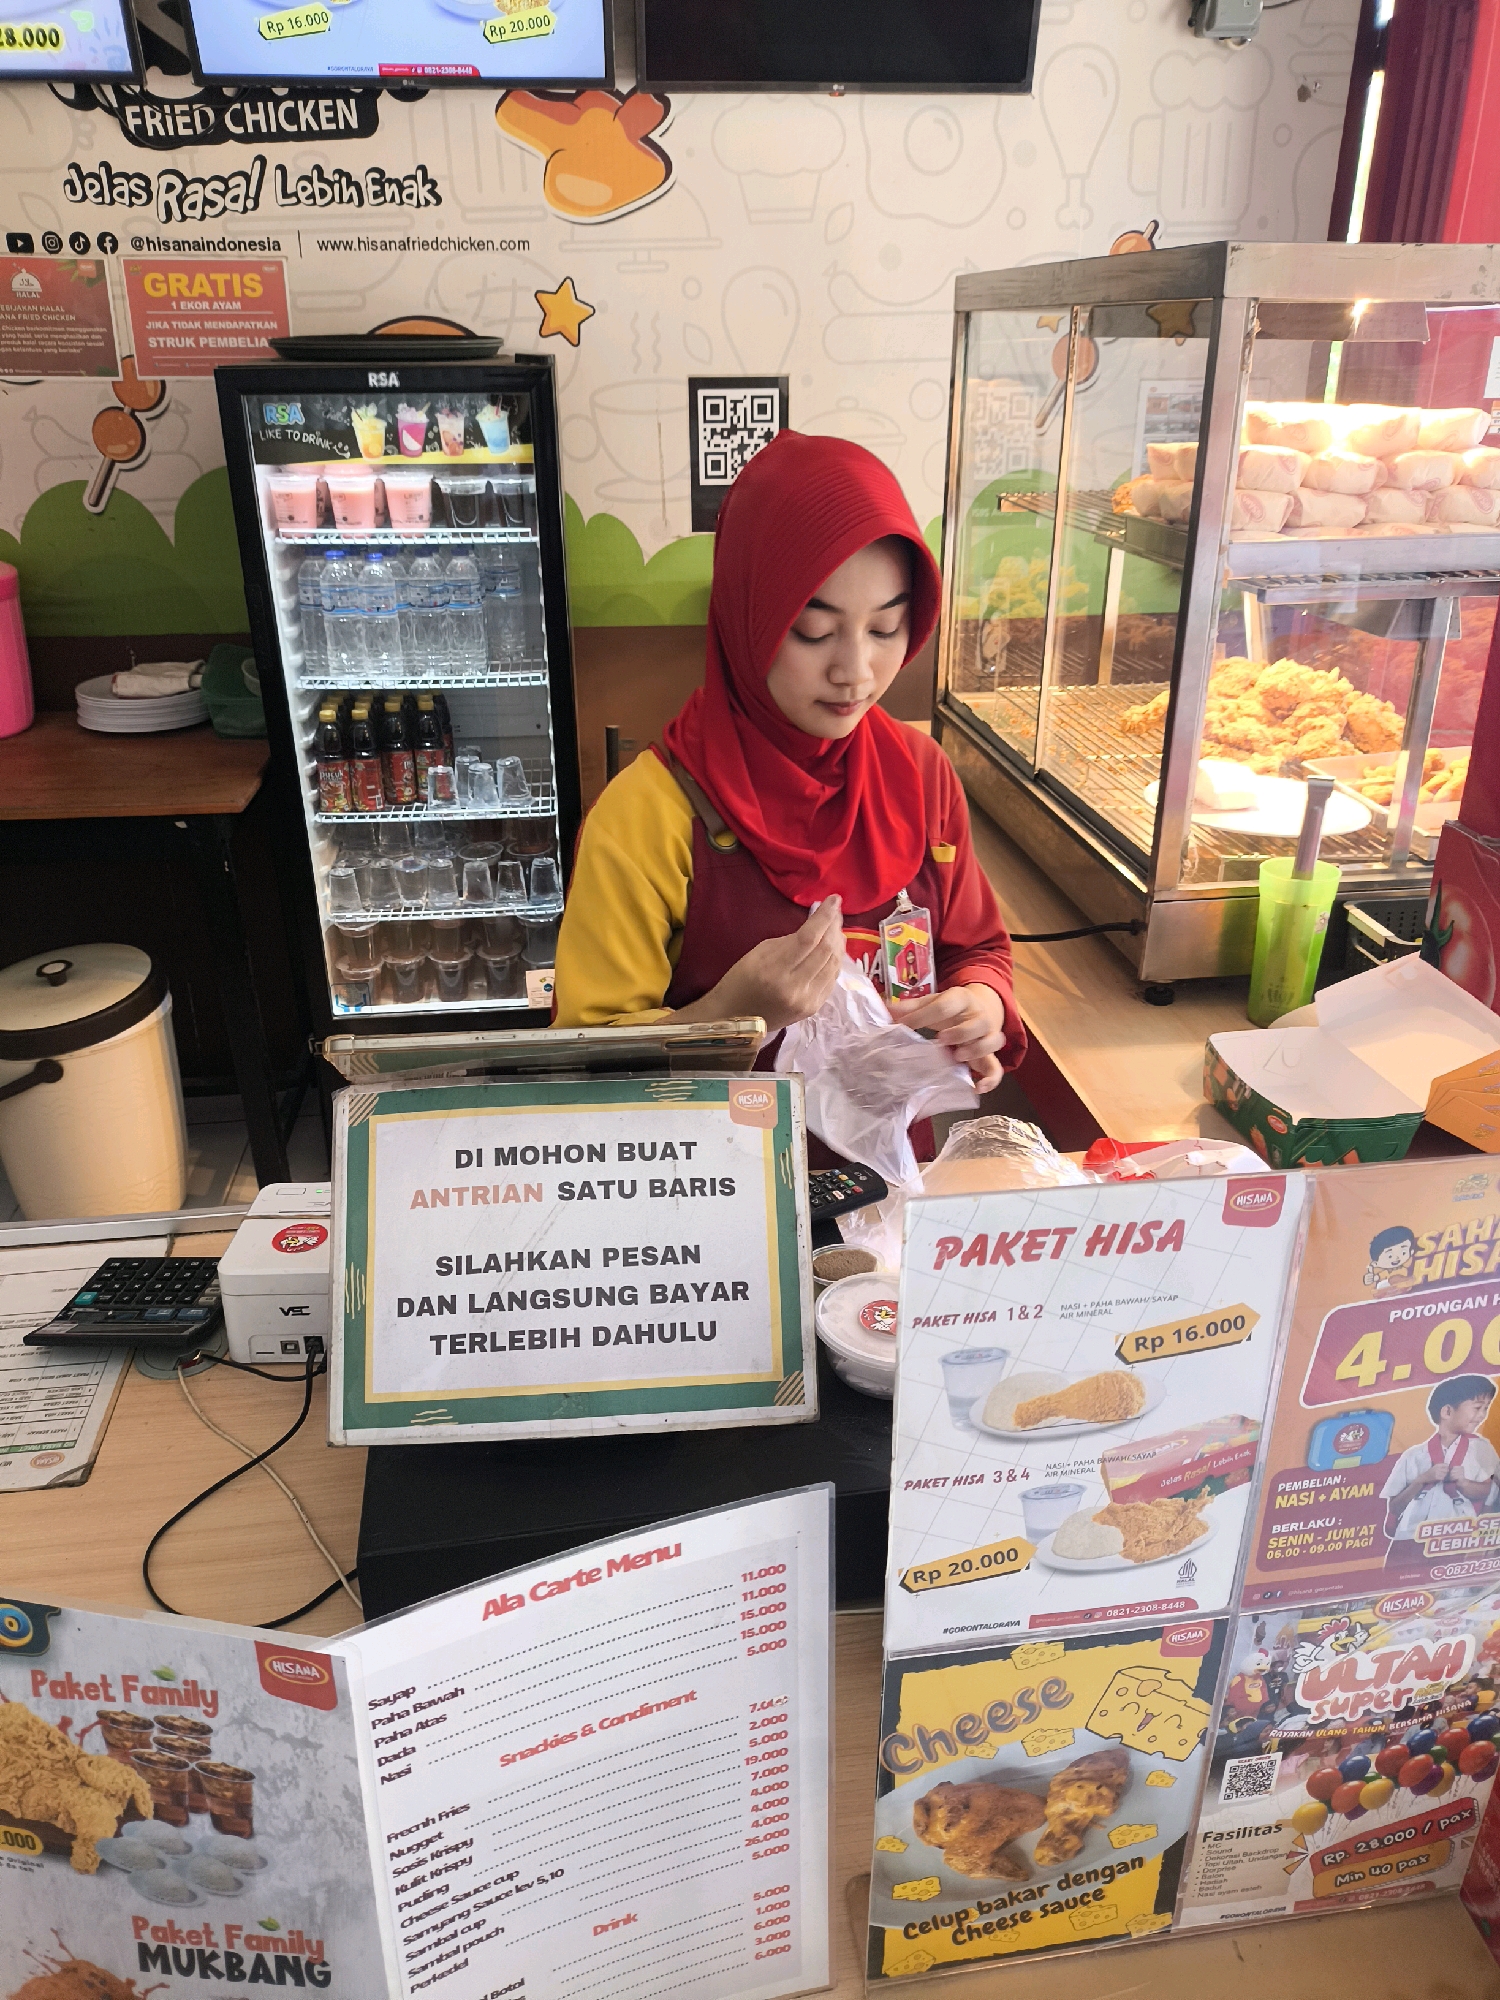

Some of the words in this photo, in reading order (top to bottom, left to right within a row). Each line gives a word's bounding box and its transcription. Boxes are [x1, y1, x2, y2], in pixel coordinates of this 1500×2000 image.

[266, 20, 285, 34] Rp
[287, 10, 329, 30] 16.000
[489, 24, 507, 40] Rp
[509, 14, 551, 34] 20.000
[124, 103, 215, 137] FRIED
[223, 98, 359, 134] CHICKEN
[64, 161, 152, 207] Jelas
[156, 154, 268, 223] Rasa!
[274, 164, 363, 208] Lebih
[363, 164, 442, 208] Enak
[130, 235, 281, 253] @hisanaindonesia
[316, 236, 531, 252] www.hisanafriedchicken.com
[143, 272, 264, 298] GRATIS
[180, 301, 210, 310] EKOR
[212, 301, 242, 310] AYAM
[146, 321, 170, 330] JIKA
[171, 321, 202, 330] TIDAK
[204, 321, 278, 330] MENDAPATKAN
[148, 336, 197, 349] STRUK
[200, 336, 271, 349] PEMBELIA
[368, 371, 400, 388] RSA
[263, 402, 305, 425] RSA
[259, 429, 282, 441] LIKE
[454, 1148, 483, 1169] DI
[493, 1142, 607, 1168] MOHON
[617, 1140, 699, 1164] BUAT
[409, 1182, 544, 1210] ANTRIAN
[556, 1178, 638, 1202] SATU
[648, 1176, 737, 1198] BARIS
[1235, 1191, 1273, 1207] HISANA
[932, 1225, 1078, 1272] PAKET
[1083, 1218, 1187, 1258] HISA
[434, 1247, 591, 1277] SILAHKAN
[602, 1244, 701, 1269] PESAN
[396, 1294, 458, 1319] DAN
[467, 1284, 639, 1315] LANGSUNG
[648, 1281, 750, 1305] BAYAR
[1059, 1312, 1074, 1320] AIR
[1075, 1308, 1114, 1319] MINERAL
[1060, 1303, 1081, 1312] NASI
[1090, 1300, 1113, 1309] PAHA
[1151, 1294, 1179, 1304] SAYAP
[1389, 1294, 1489, 1323] POTONGAN
[911, 1313, 961, 1329] PAKET
[962, 1310, 997, 1325] HISA
[1134, 1335, 1165, 1353] Rp
[1171, 1314, 1246, 1346] 16.000
[429, 1326, 581, 1357] TERLEBIH
[591, 1320, 718, 1348] DAHULU
[1045, 1462, 1066, 1471] NASI
[1073, 1459, 1095, 1468] PAHA
[1060, 1467, 1096, 1477] MINERAL
[903, 1477, 950, 1491] PAKET
[951, 1473, 985, 1487] HISA
[1160, 1474, 1182, 1488] Jelas
[1275, 1490, 1314, 1509] NASI
[1329, 1482, 1375, 1502] AYAM
[1267, 1532, 1314, 1550] SENIN
[1420, 1520, 1474, 1538] BEKAL
[1266, 1548, 1300, 1560] 06.00
[1309, 1542, 1342, 1556] 09.00
[1345, 1536, 1374, 1550] PAGI
[1429, 1536, 1480, 1552] LEBIH
[913, 1568, 942, 1586] Rp
[948, 1547, 1020, 1577] 20.000
[482, 1592, 526, 1621] Ala
[529, 1567, 602, 1602] Carte
[606, 1542, 682, 1578] Menu
[942, 1619, 1021, 1635] #GORONTALORAYA
[1105, 1600, 1186, 1618] 0821-2308-8448
[1383, 1595, 1425, 1613] HISANA
[368, 1686, 416, 1711] Sayap
[740, 1563, 787, 1584] 11.000
[1171, 1630, 1204, 1642] HISANA
[272, 1660, 320, 1679] HISANA
[371, 1709, 411, 1730] Paha
[412, 1687, 465, 1714] Bawah
[741, 1582, 787, 1603] 11.000
[1301, 1638, 1467, 1702] ULTAH
[374, 1726, 413, 1748] Paha
[415, 1713, 448, 1733] Atas
[740, 1601, 787, 1621] 15.000
[30, 1669, 116, 1702] Paket
[121, 1674, 219, 1718] Family
[377, 1745, 417, 1768] Dada
[740, 1620, 787, 1640] 15.000
[380, 1763, 412, 1785] Nasi
[746, 1638, 787, 1657] 5.000
[881, 1675, 1075, 1776] Cheese
[500, 1733, 579, 1768] Snackies
[598, 1689, 698, 1731] Condiment
[1268, 1729, 1314, 1738] RAYAKAN
[1315, 1727, 1348, 1738] ULANG
[1352, 1724, 1386, 1735] TAHUN
[389, 1830, 445, 1861] Nugget
[749, 1713, 788, 1731] 2.000
[392, 1856, 429, 1879] Sosis
[430, 1837, 474, 1862] Krispy
[748, 1730, 788, 1748] 5.000
[429, 1855, 473, 1880] Krispy
[744, 1747, 789, 1767] 19.000
[398, 1883, 450, 1912] Puding
[751, 1764, 789, 1782] 7.000
[1202, 1823, 1283, 1843] Fasilitas
[1322, 1852, 1350, 1866] Rp.
[1356, 1828, 1416, 1853] 28.000
[1439, 1809, 1473, 1831] pax
[400, 1901, 450, 1929] Cheese
[450, 1881, 492, 1906] Sauce
[493, 1869, 520, 1887] cup
[750, 1780, 790, 1797] 4.000
[1204, 1853, 1240, 1862] Dekorasi
[1242, 1847, 1280, 1858] Backdrop
[1206, 1848, 1233, 1856] Sound
[402, 1908, 472, 1947] Samyang
[515, 1880, 535, 1894] lev
[750, 1796, 790, 1814] 4.000
[1335, 1873, 1365, 1887] Min
[1371, 1864, 1392, 1876] 40
[1398, 1855, 1430, 1871] pax
[405, 1928, 459, 1963] Sambal
[751, 1812, 790, 1829] 4.000
[753, 1885, 790, 1901] 5.000
[903, 1907, 970, 1940] Celup
[976, 1882, 1051, 1917] bakar
[1056, 1856, 1145, 1893] dengan
[408, 1944, 461, 1979] Sambal
[462, 1925, 505, 1953] pouch
[744, 1828, 790, 1847] 26.000
[755, 1899, 790, 1916] 1.000
[951, 1914, 1034, 1946] Cheese
[1038, 1888, 1107, 1920] sauce
[410, 1957, 469, 1994] Perkedel
[751, 1843, 790, 1861] 5.000
[592, 1912, 639, 1937] Drink
[753, 1914, 791, 1931] 6.000
[131, 1914, 219, 1949] Paket
[224, 1923, 325, 1964] Family
[754, 1929, 791, 1946] 3.000
[754, 1943, 791, 1961] 6.000
[137, 1941, 332, 1989] MUKBANG
